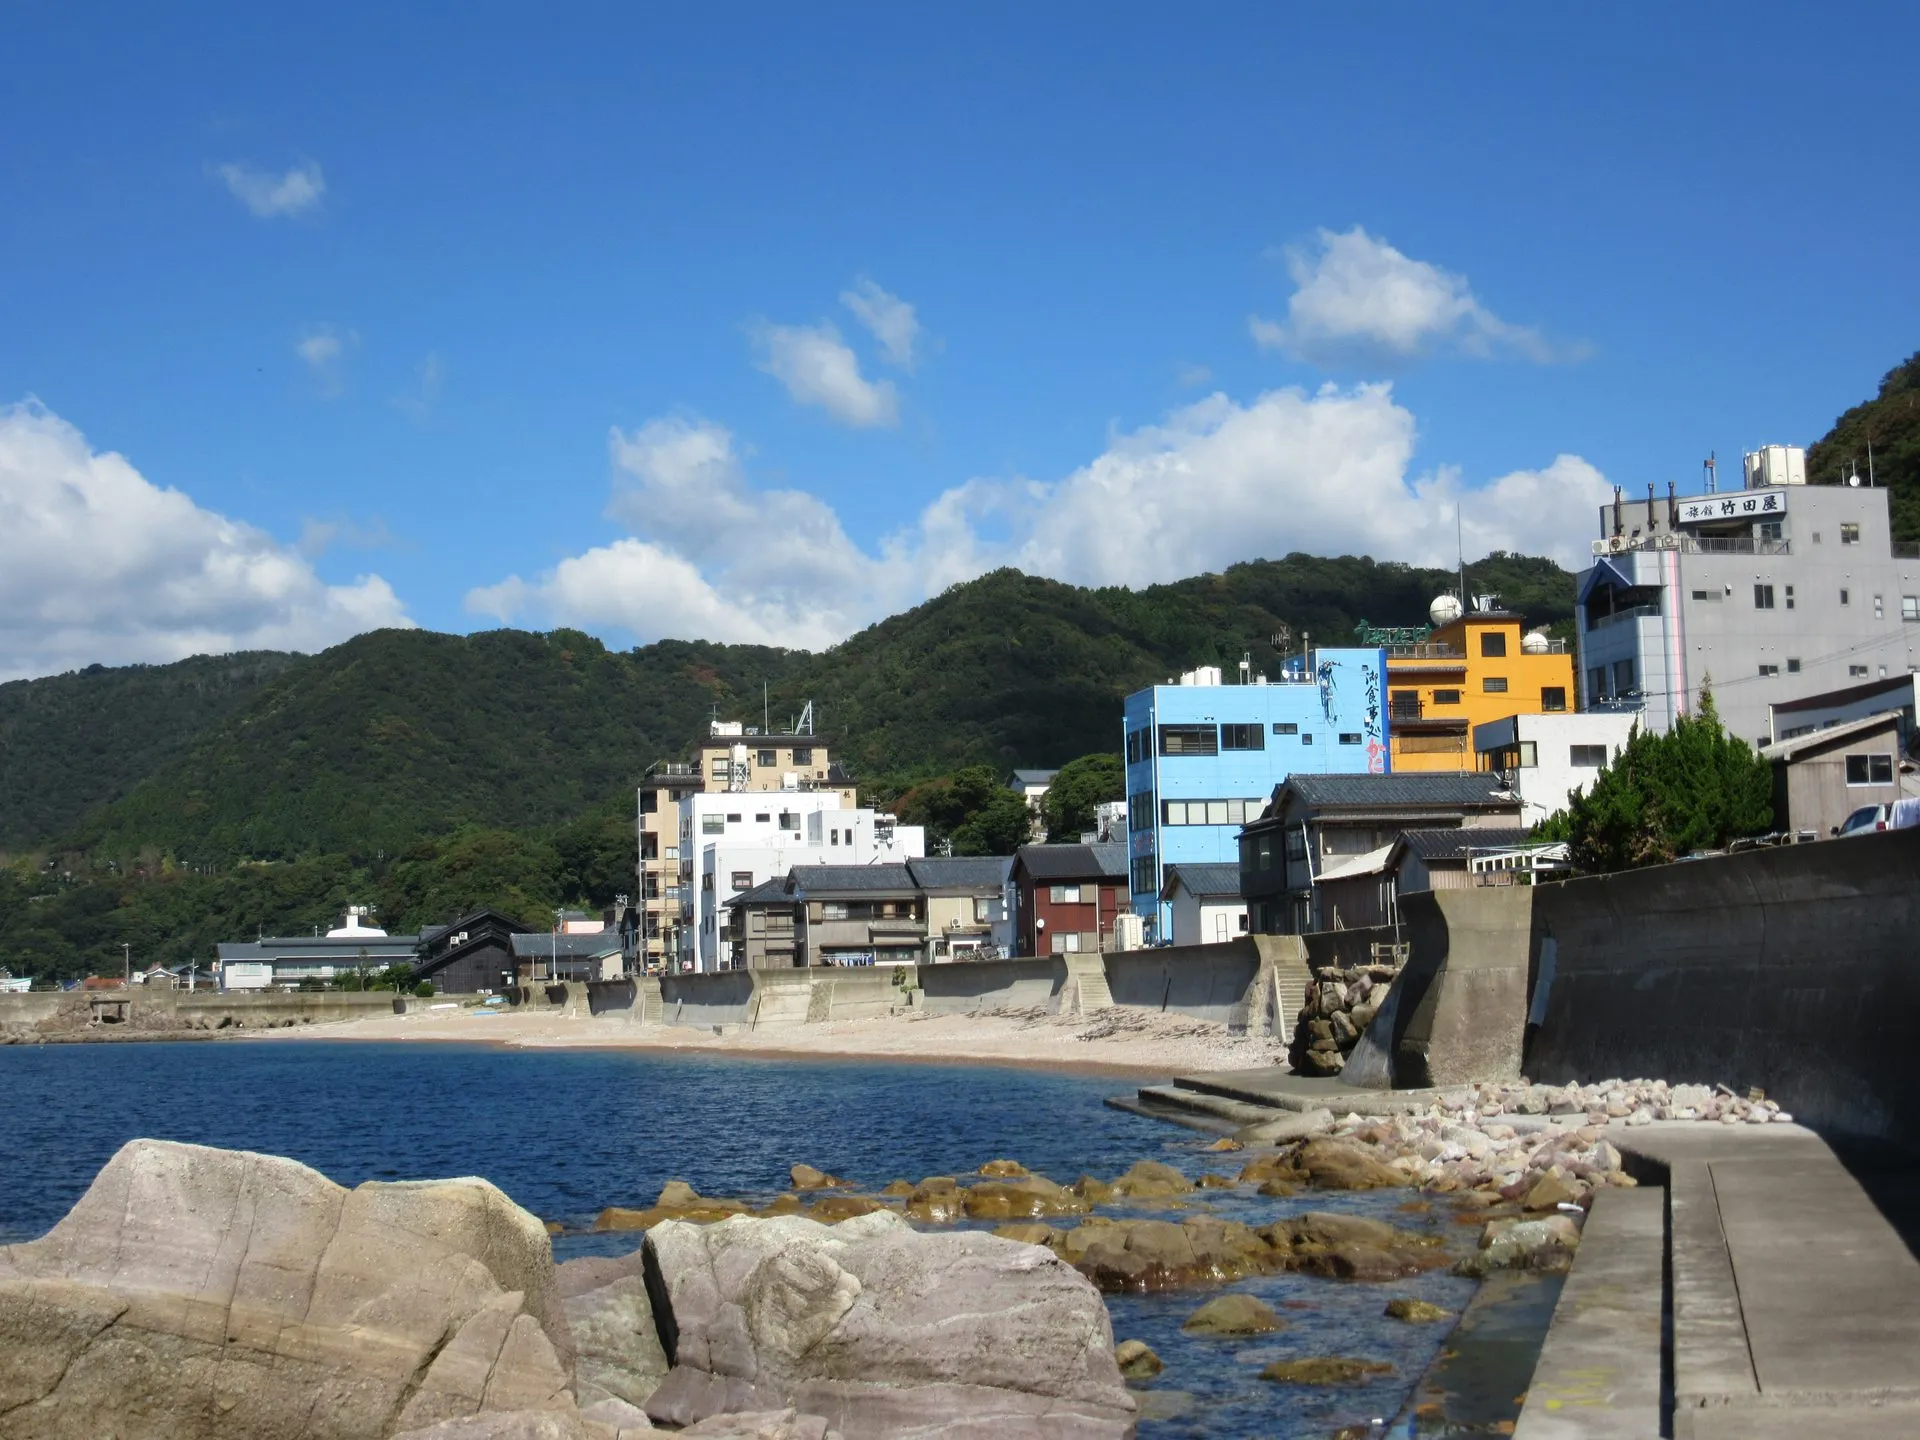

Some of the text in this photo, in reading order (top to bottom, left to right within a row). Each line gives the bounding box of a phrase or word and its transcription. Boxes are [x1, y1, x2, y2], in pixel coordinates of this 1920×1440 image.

[1685, 495, 1778, 518] 旅館 竹田屋
[1365, 738, 1387, 774] かに
